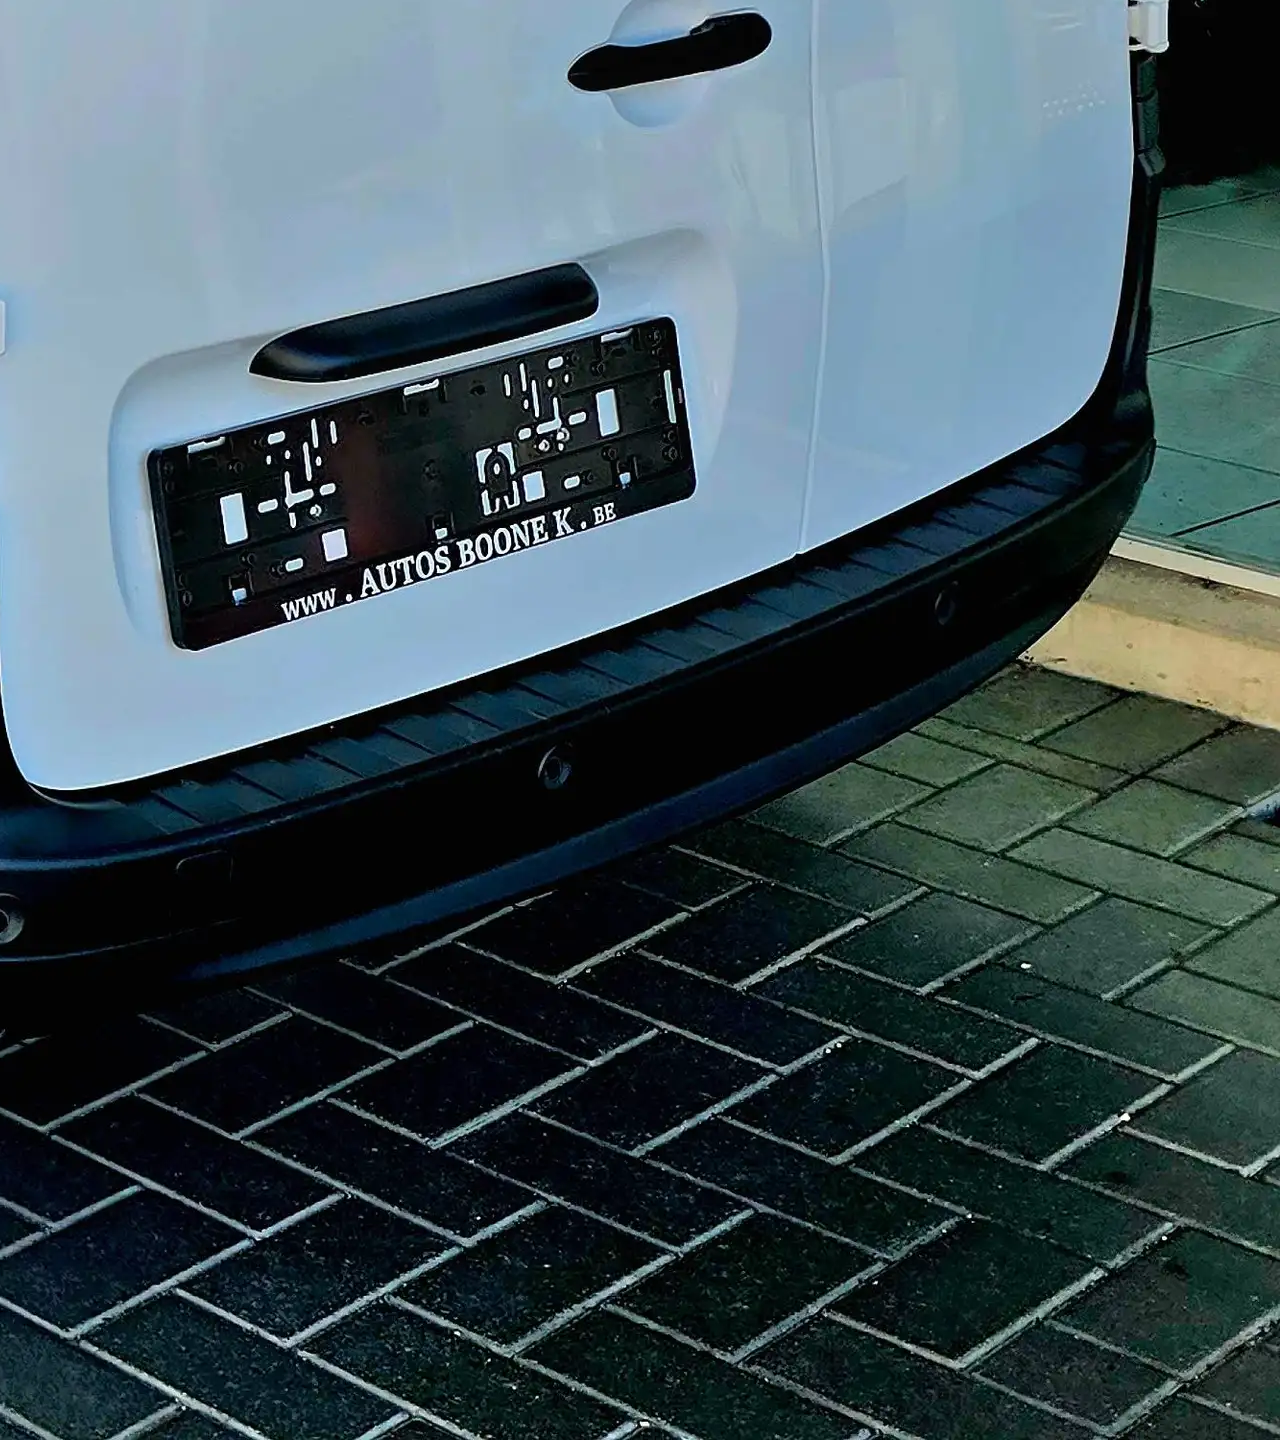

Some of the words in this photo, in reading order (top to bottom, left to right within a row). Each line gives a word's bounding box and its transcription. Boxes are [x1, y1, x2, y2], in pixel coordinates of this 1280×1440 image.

[360, 546, 452, 599] AUTOS
[458, 515, 550, 568] BOONE
[552, 506, 575, 538] K
[592, 502, 617, 526] BE
